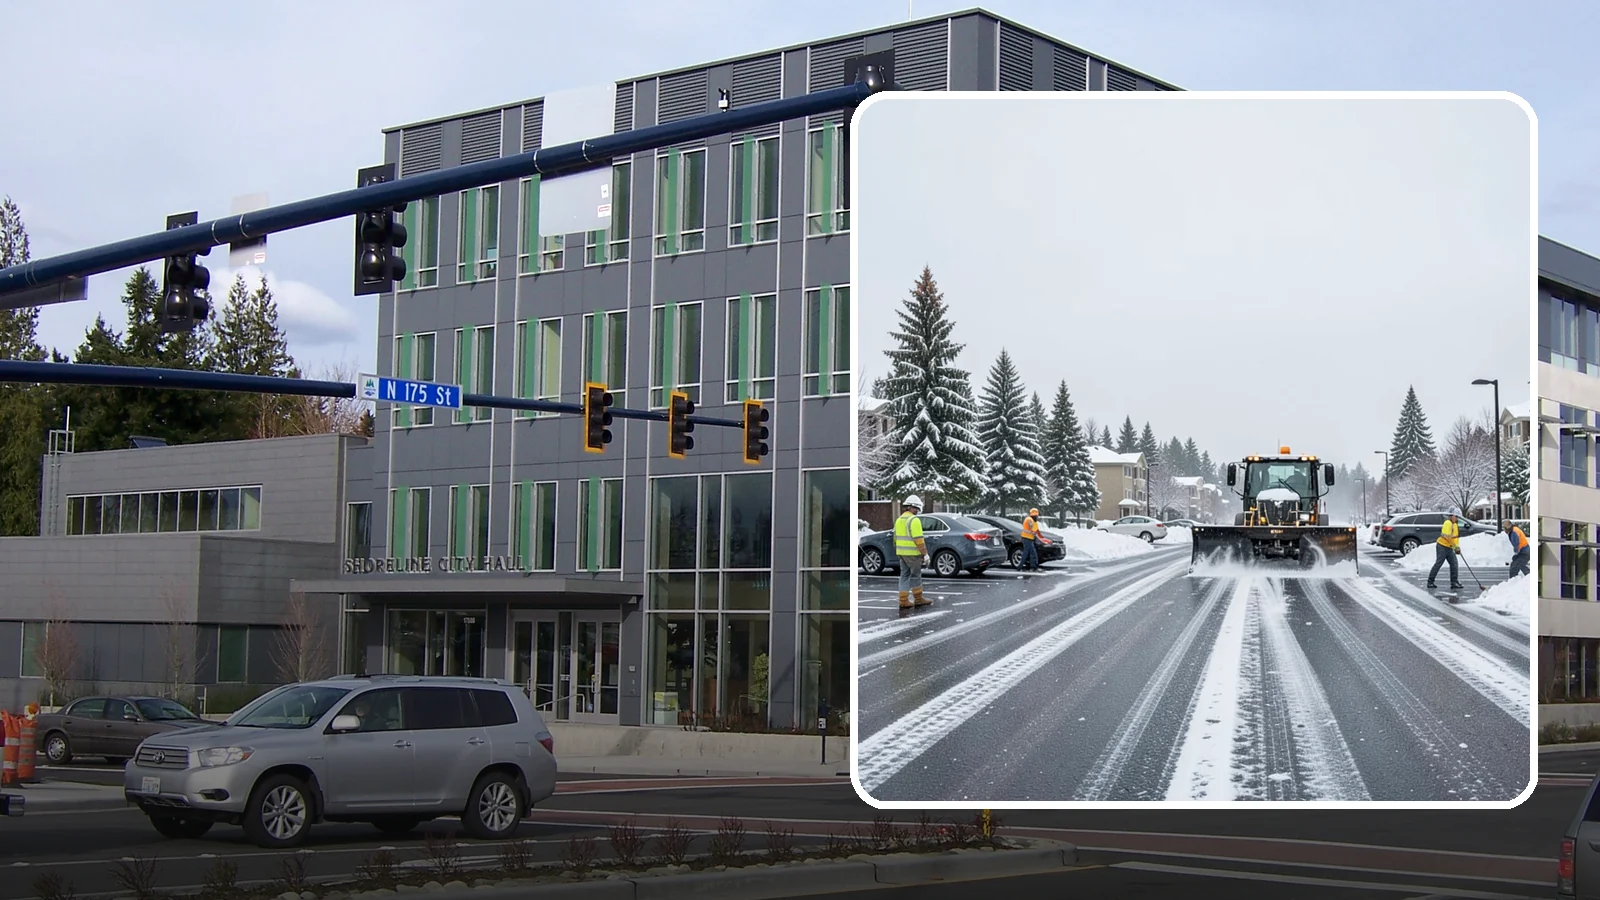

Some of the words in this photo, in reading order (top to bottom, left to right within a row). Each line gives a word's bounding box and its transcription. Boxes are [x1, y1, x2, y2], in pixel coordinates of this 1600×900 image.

[387, 381, 396, 400] N
[405, 382, 427, 403] 175
[436, 387, 451, 406] St
[344, 557, 432, 574] SHORELINE
[438, 556, 475, 572] CITY
[483, 555, 525, 571] HALL
